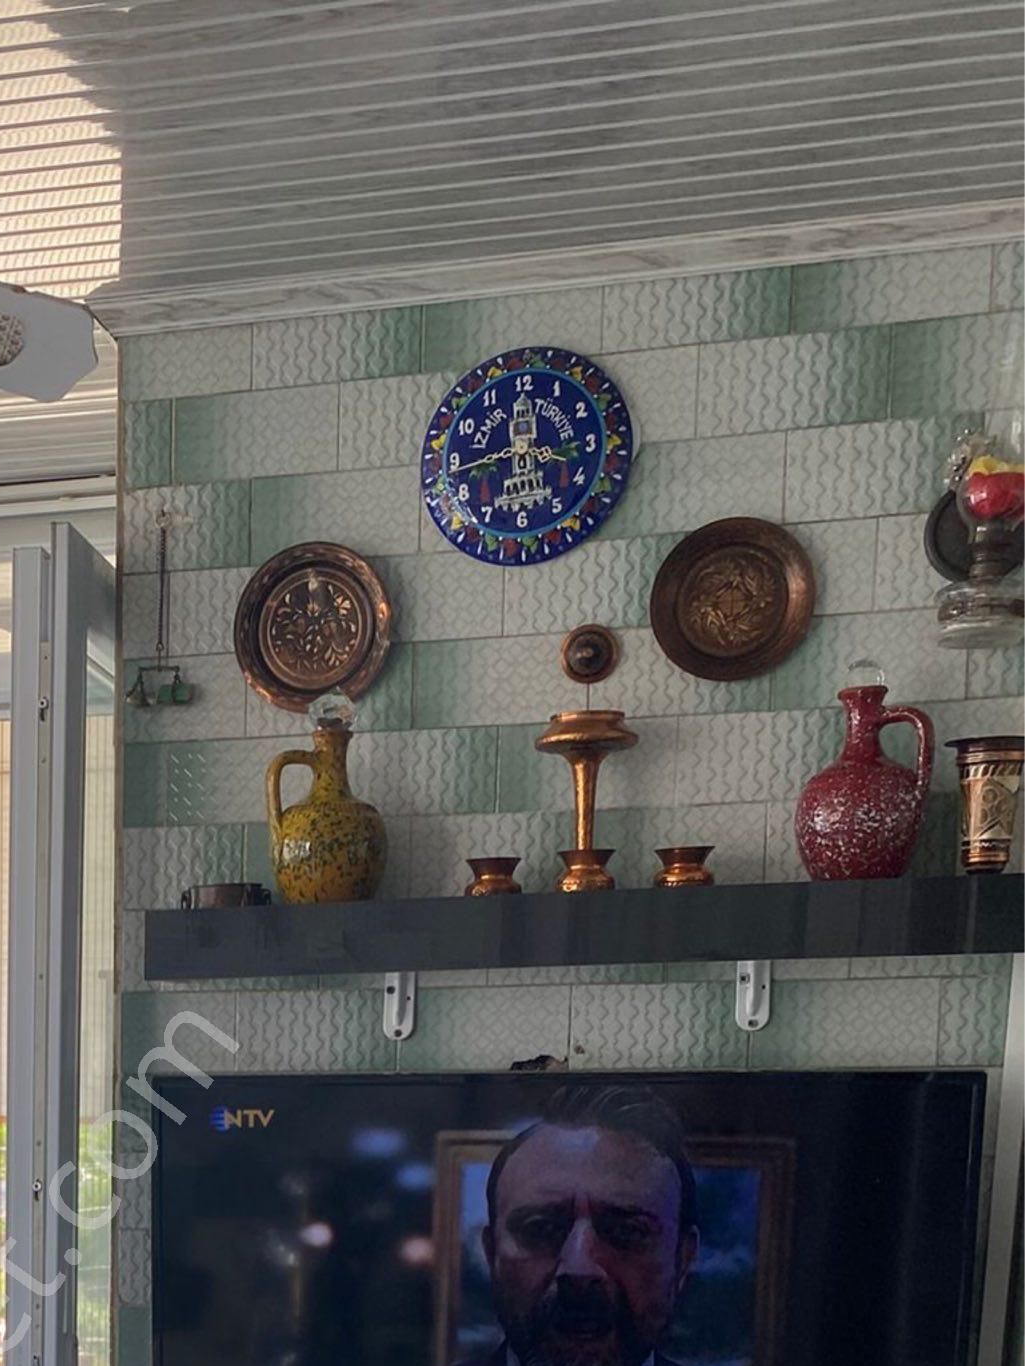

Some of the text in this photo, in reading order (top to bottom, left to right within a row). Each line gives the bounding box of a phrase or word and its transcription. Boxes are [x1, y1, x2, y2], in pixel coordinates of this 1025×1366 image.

[516, 374, 533, 392] 12
[553, 380, 561, 397] 1
[483, 389, 496, 407] 11
[534, 397, 574, 441] TÜRKİYE
[576, 401, 588, 419] 2
[458, 417, 474, 436] 10
[469, 408, 507, 449] İZMİR
[585, 433, 596, 452] 3
[449, 452, 460, 471] 9
[573, 466, 586, 485] 4
[458, 483, 470, 501] 8
[481, 505, 493, 523] 7
[552, 497, 563, 515] 5
[516, 512, 527, 529] 6
[224, 1109, 275, 1128] NTV
